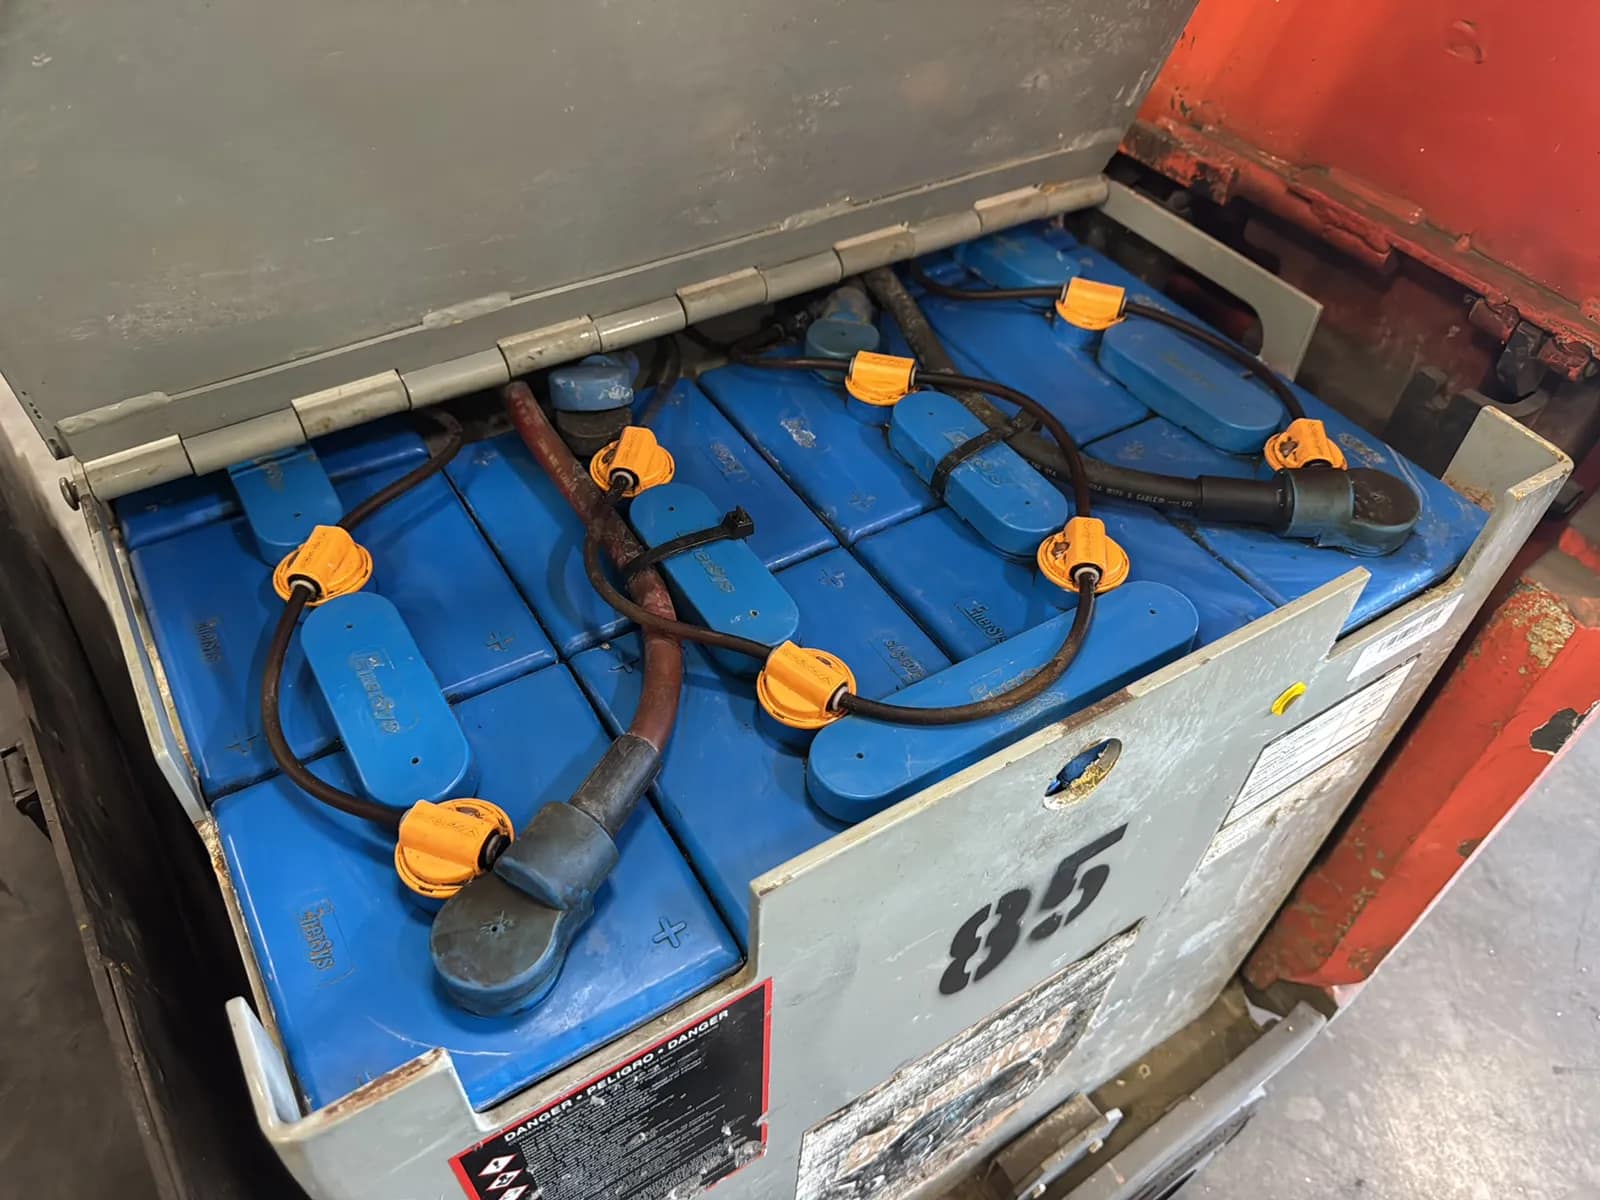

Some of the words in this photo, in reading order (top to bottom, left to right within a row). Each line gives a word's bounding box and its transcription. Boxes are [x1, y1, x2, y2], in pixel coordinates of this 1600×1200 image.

[938, 822, 1129, 995] 85
[504, 1099, 573, 1143] DANGER
[586, 1052, 654, 1096] PELIGRO
[667, 1009, 729, 1050] DANGER
